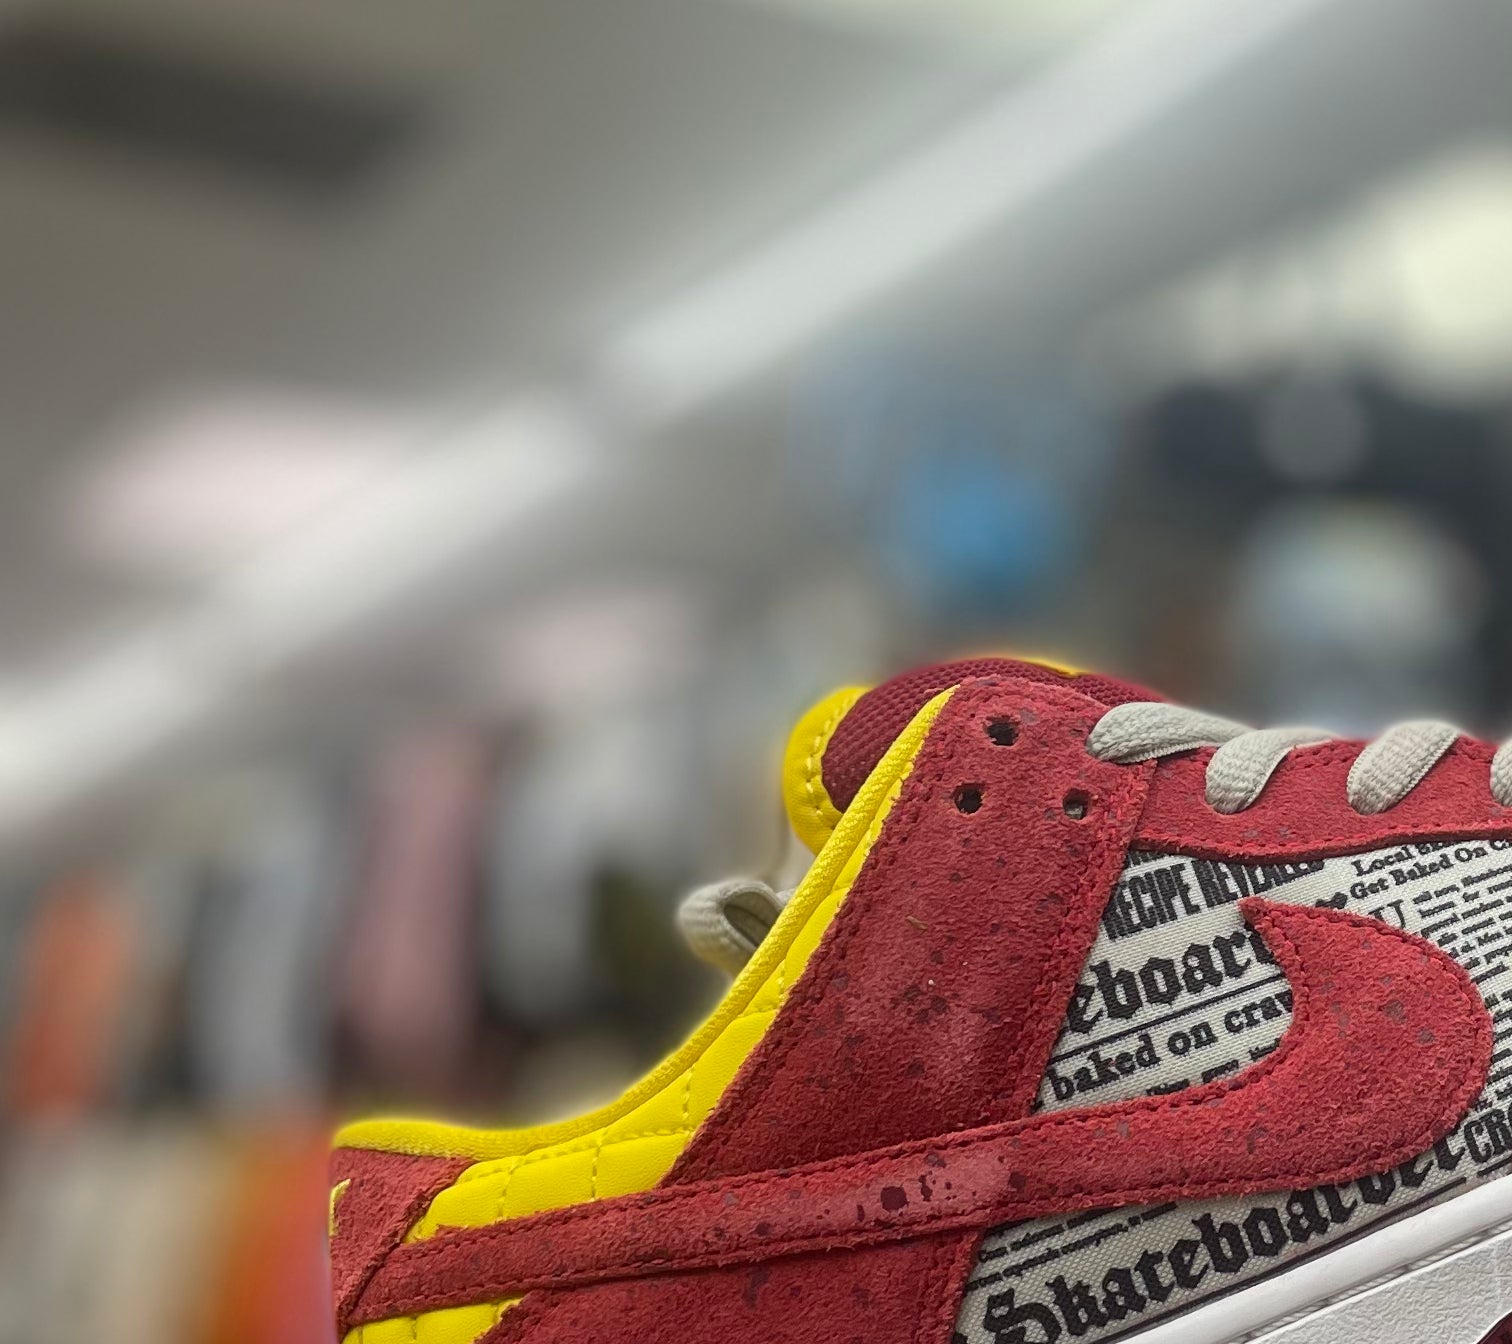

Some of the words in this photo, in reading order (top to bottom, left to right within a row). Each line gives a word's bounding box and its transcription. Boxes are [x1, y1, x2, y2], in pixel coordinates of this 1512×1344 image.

[1192, 860, 1325, 908] REVE
[1350, 877, 1390, 900] Get
[1389, 854, 1453, 885] Baked
[1454, 845, 1488, 863] On
[1351, 846, 1412, 876] Local
[1048, 1034, 1160, 1100] baked
[1167, 1021, 1218, 1055] on
